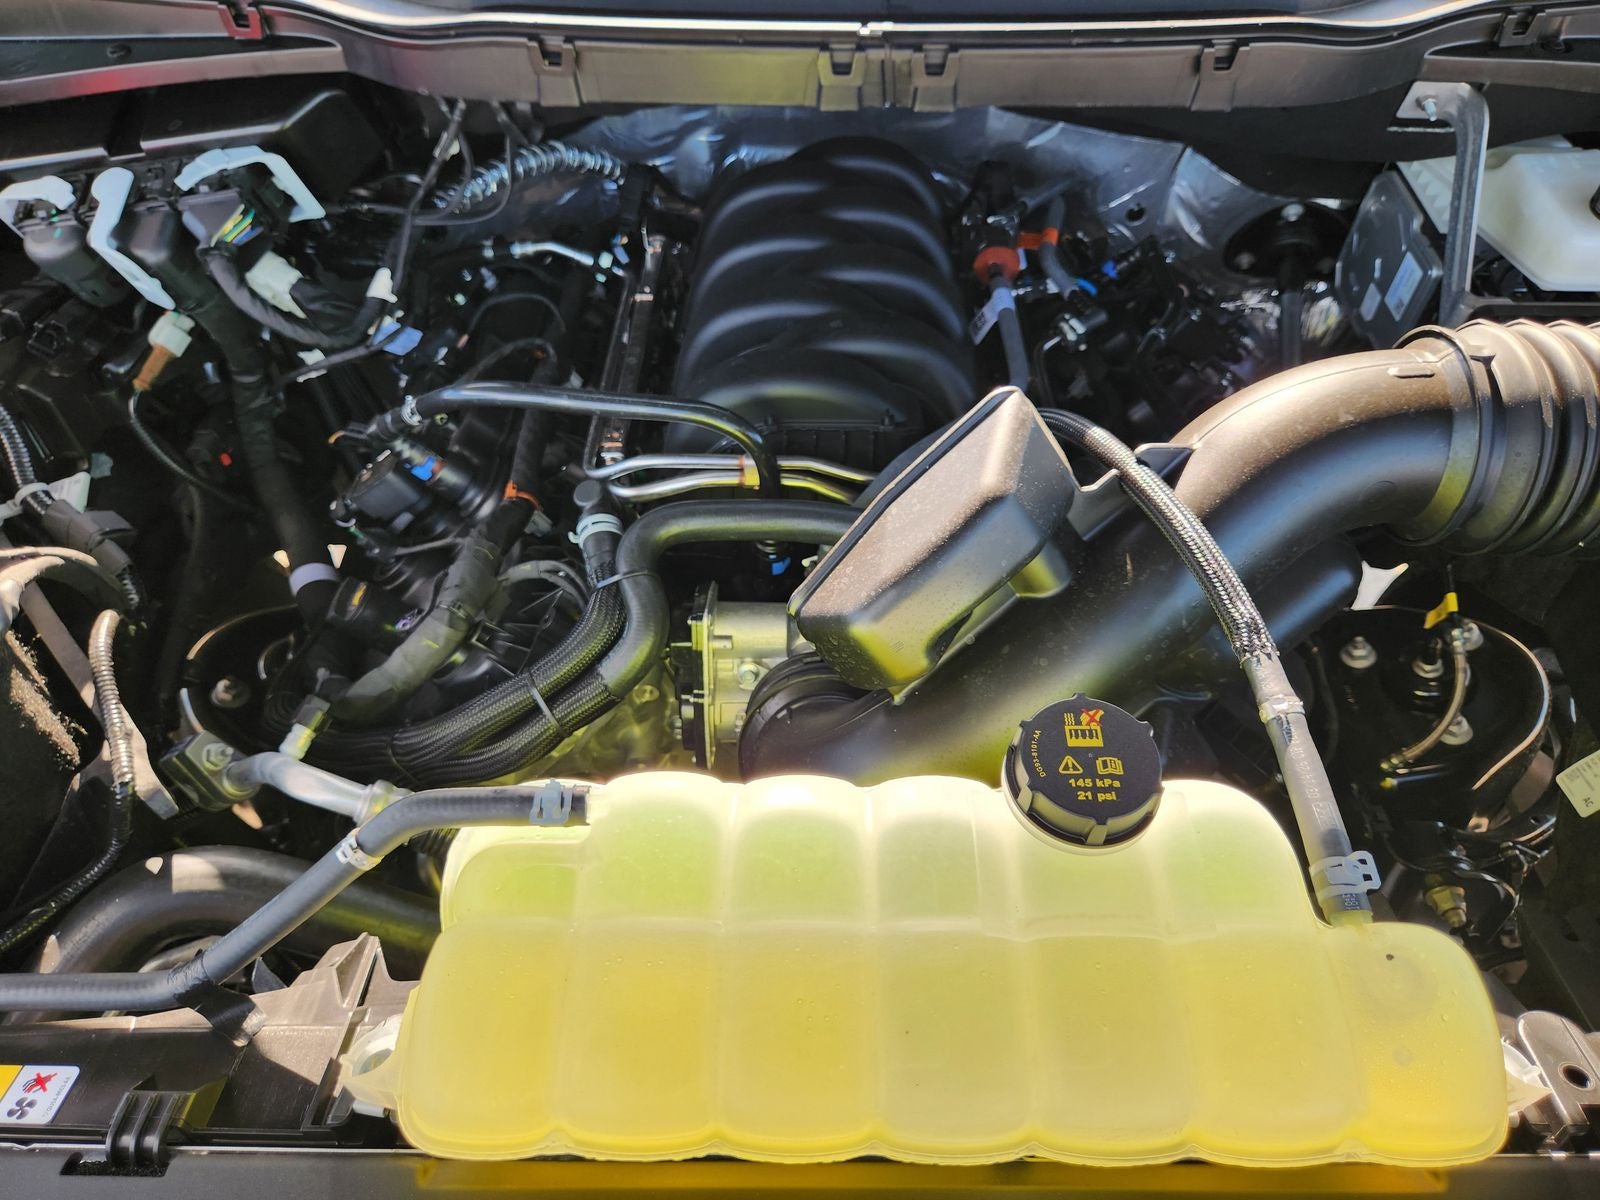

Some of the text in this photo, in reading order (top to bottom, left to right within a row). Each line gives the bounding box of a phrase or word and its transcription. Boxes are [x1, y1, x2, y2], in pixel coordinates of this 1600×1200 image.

[1069, 778, 1120, 787] 145 kPa
[1077, 791, 1117, 802] 21 psi
